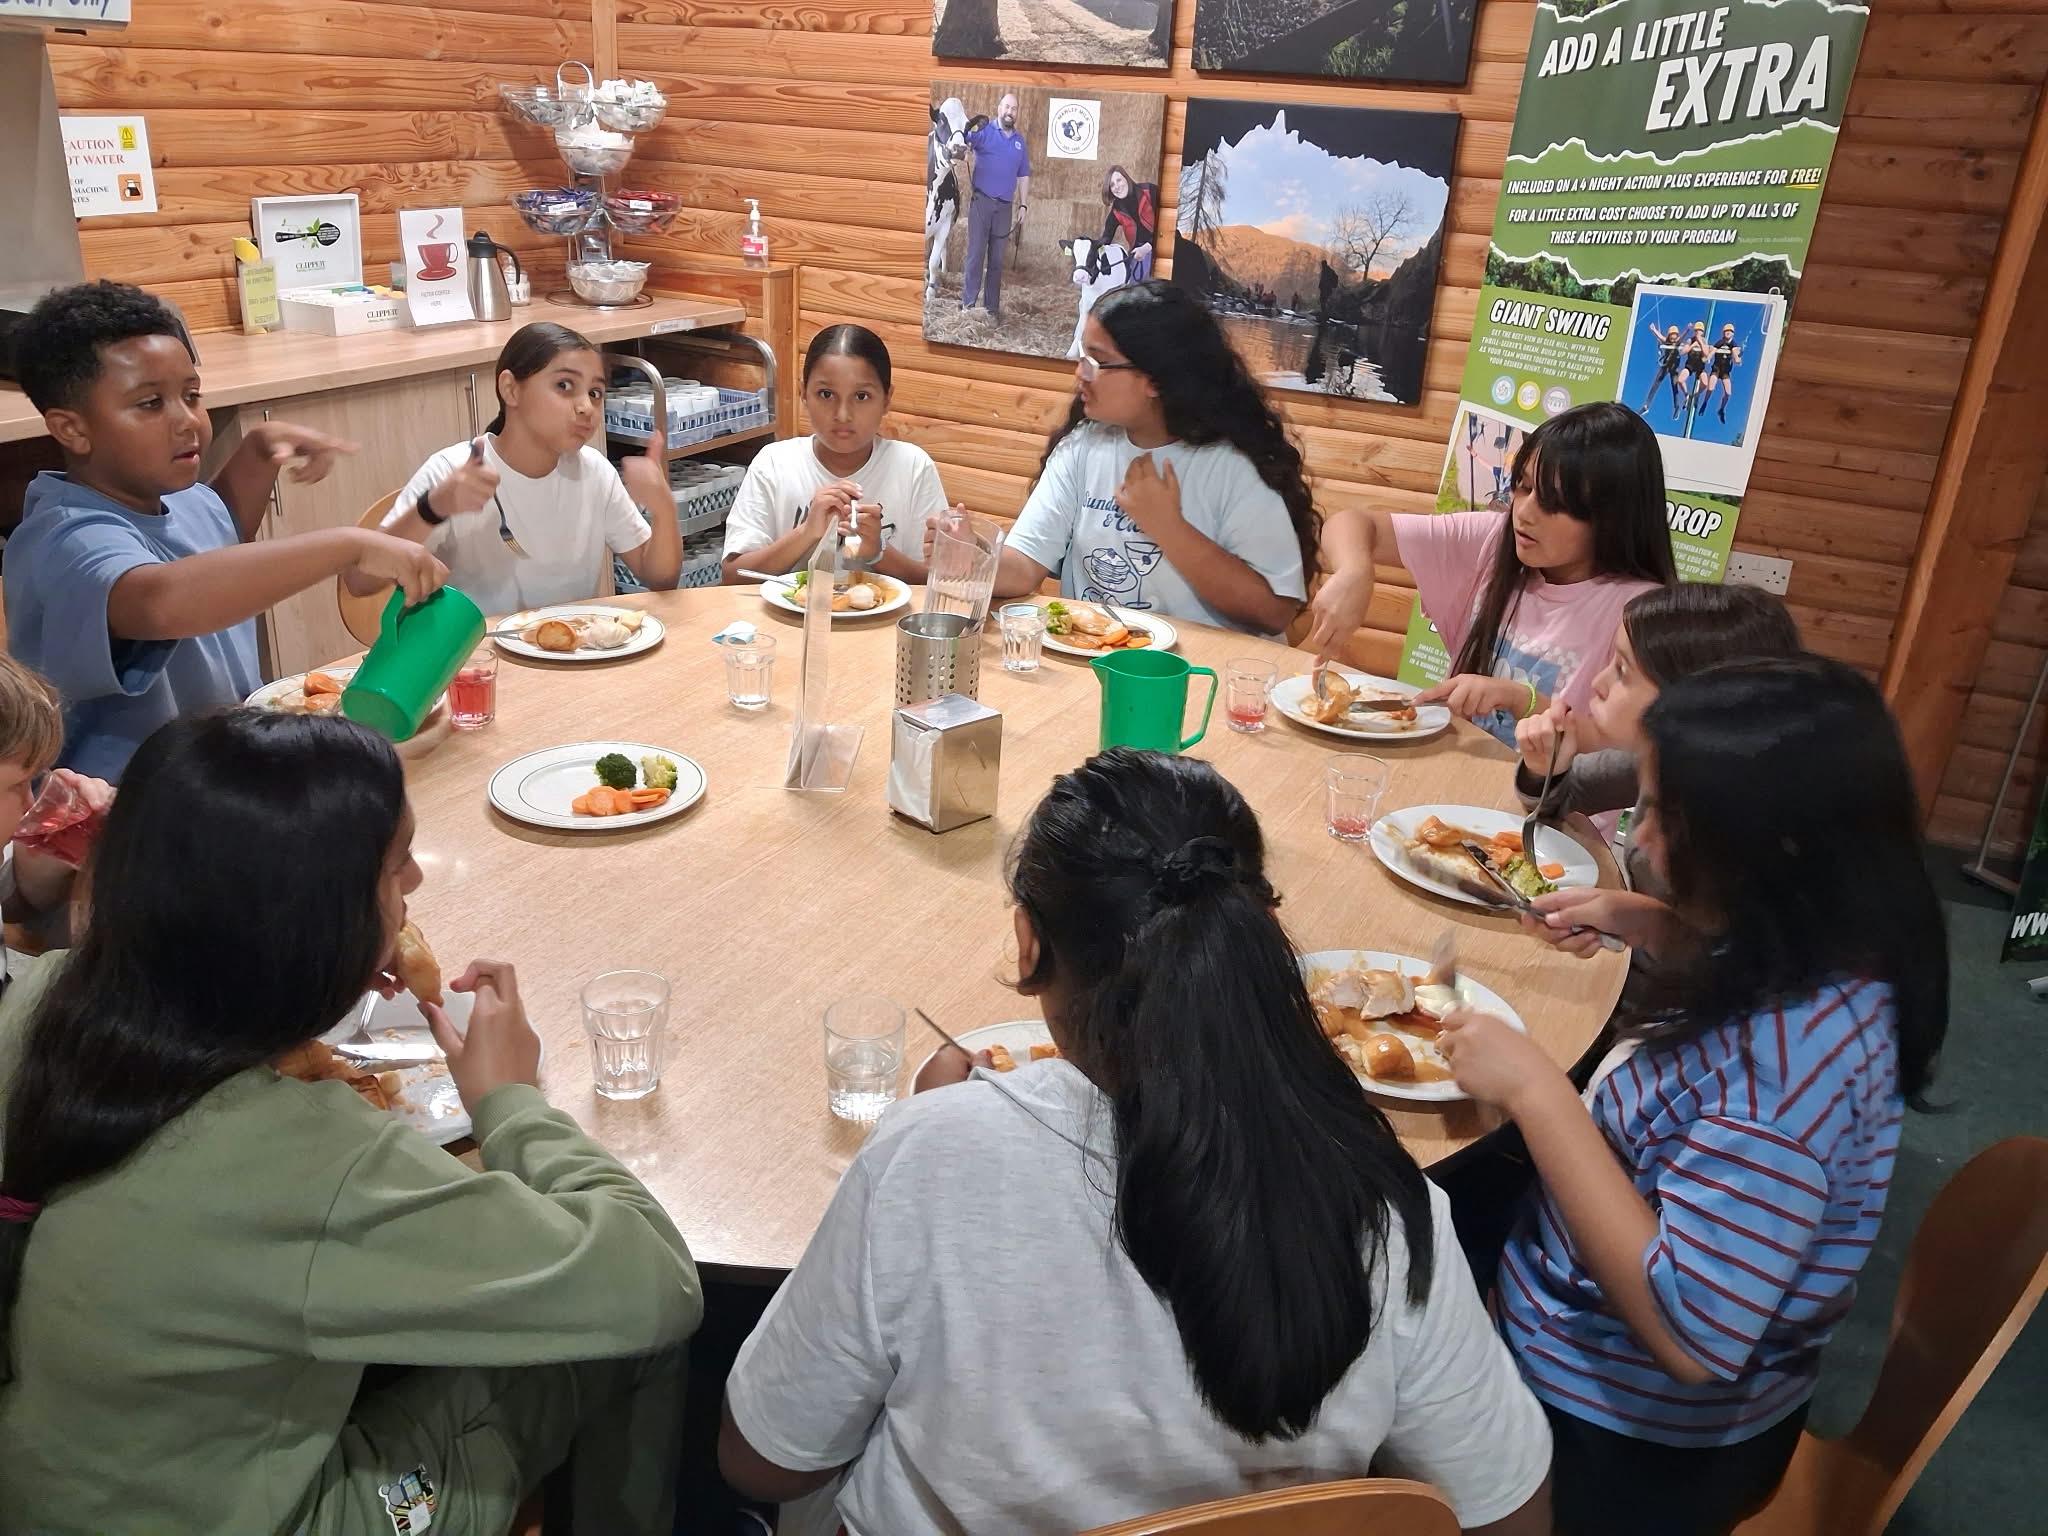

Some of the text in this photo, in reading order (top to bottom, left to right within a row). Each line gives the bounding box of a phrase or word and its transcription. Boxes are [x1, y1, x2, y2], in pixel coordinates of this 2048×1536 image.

[1538, 6, 1731, 78] ADD A LITTLE
[1645, 34, 1831, 132] EXTRA
[64, 139, 115, 150] AUTION
[83, 154, 125, 166] WATER
[1507, 167, 1823, 195] INCLUDED ON A 4 NIGHT ACTION PLUS EXPERIENCE FOR FREE!
[1508, 202, 1799, 223] FOR A LITTLE EXTRA COST CHOOSE TO ADD UP TO ALL 3 OF
[1550, 228, 1738, 245] THESE ACTIVITIES TO YOUR PROGRAM
[1490, 297, 1612, 341] GIANT SWING
